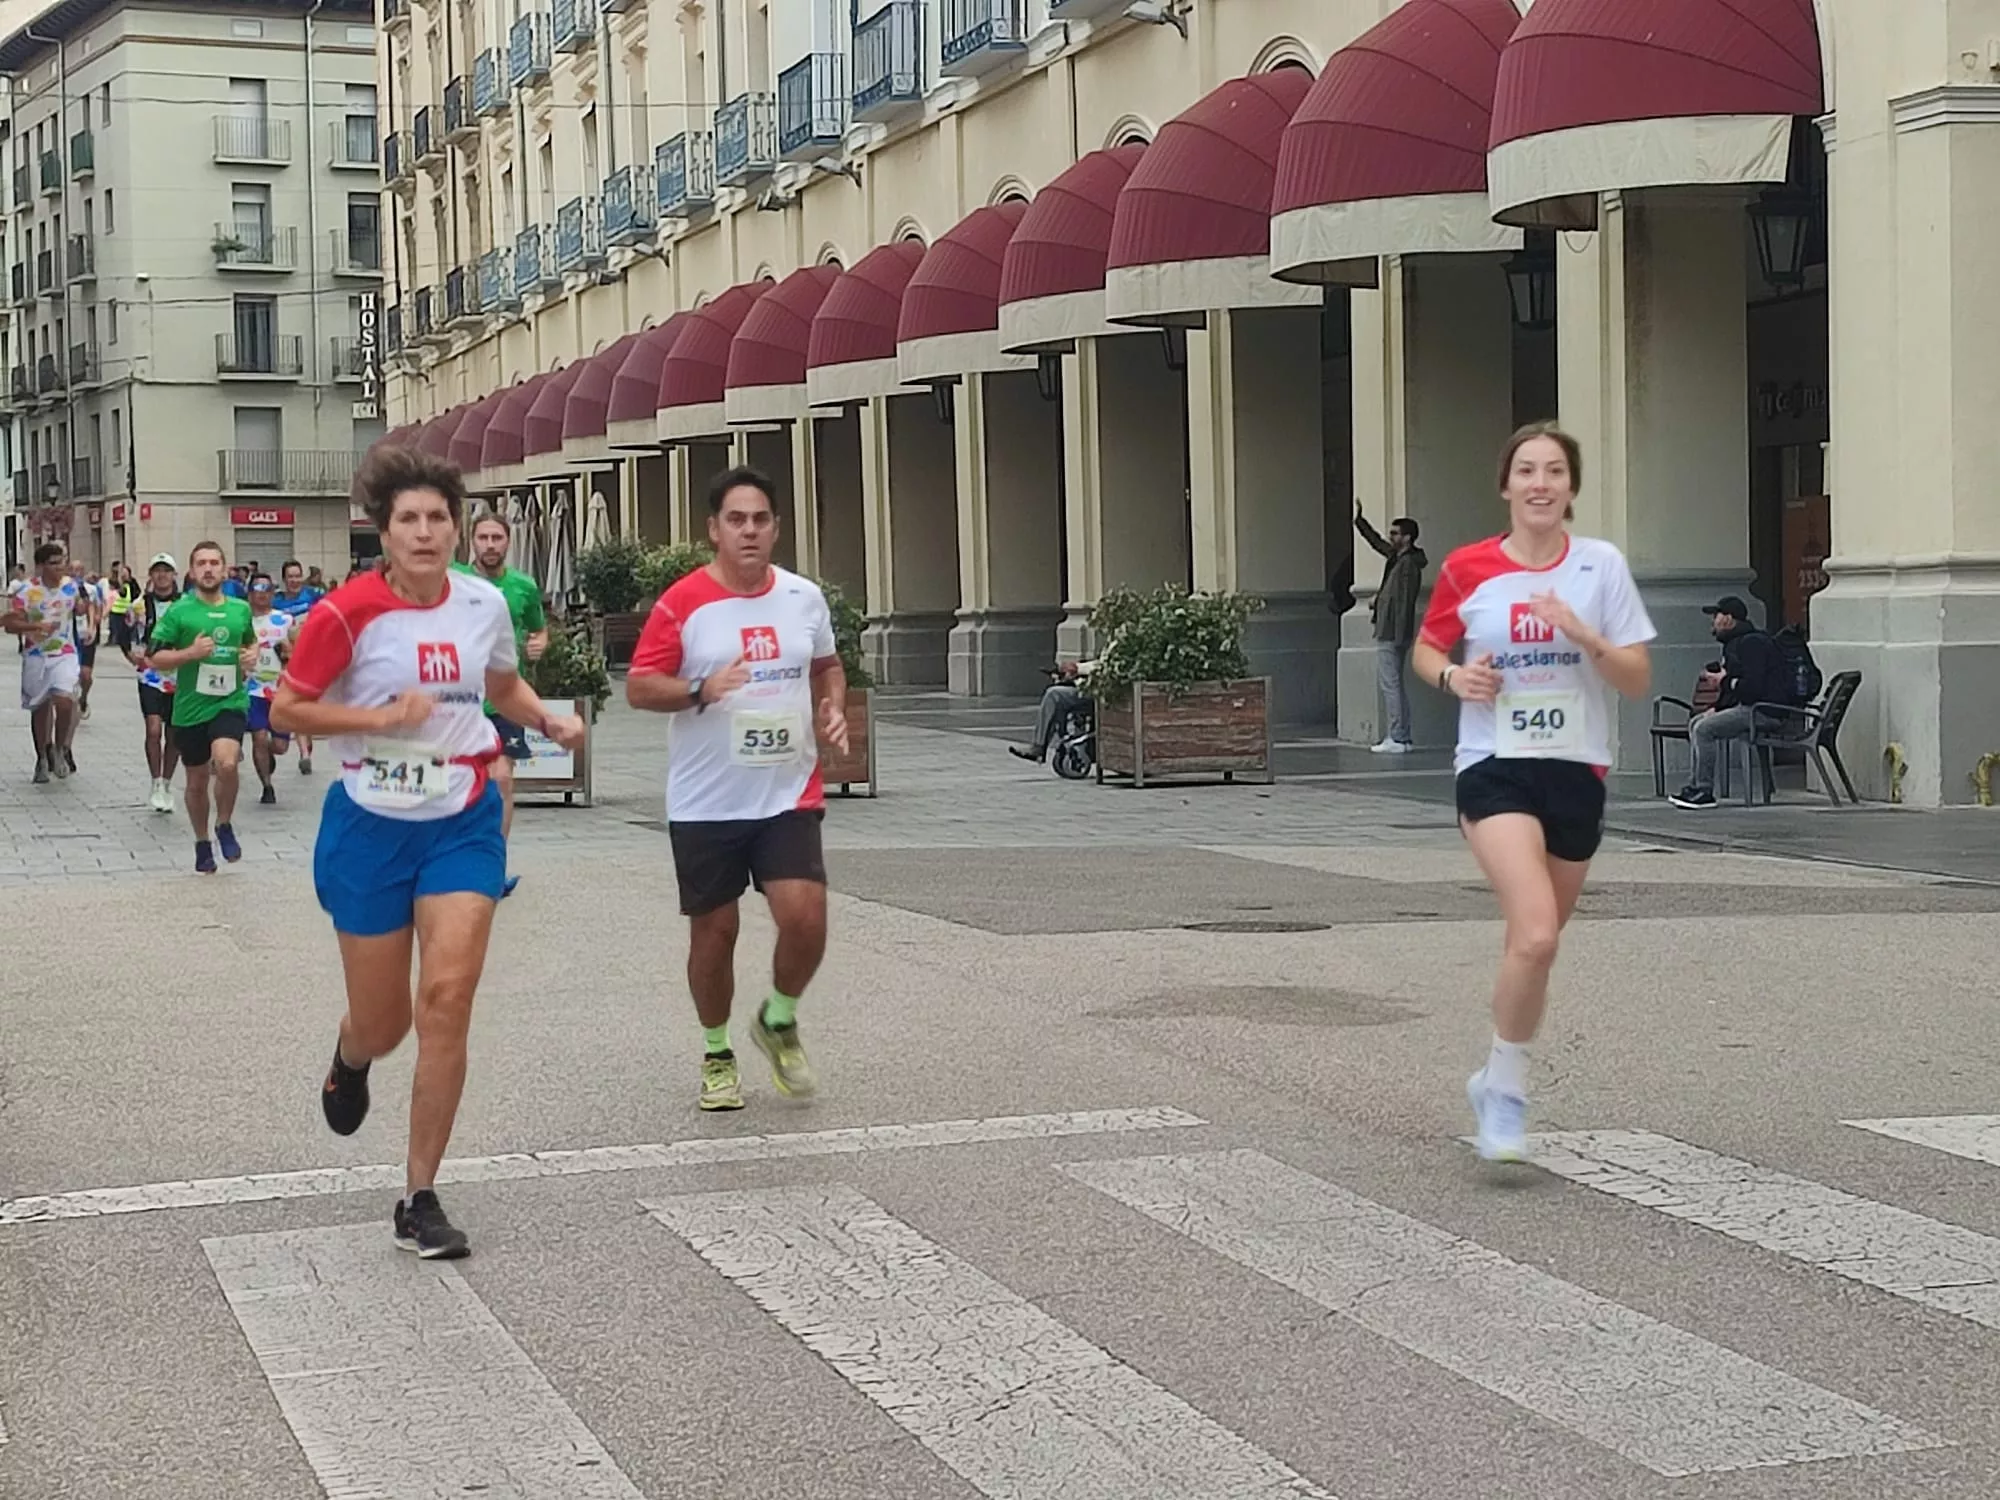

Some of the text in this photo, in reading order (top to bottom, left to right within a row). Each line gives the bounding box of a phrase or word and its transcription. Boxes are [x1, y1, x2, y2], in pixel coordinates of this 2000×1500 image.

[361, 292, 376, 398] HOSTAL
[1512, 708, 1565, 731] 540
[744, 728, 790, 747] 539
[373, 760, 425, 785] 541
